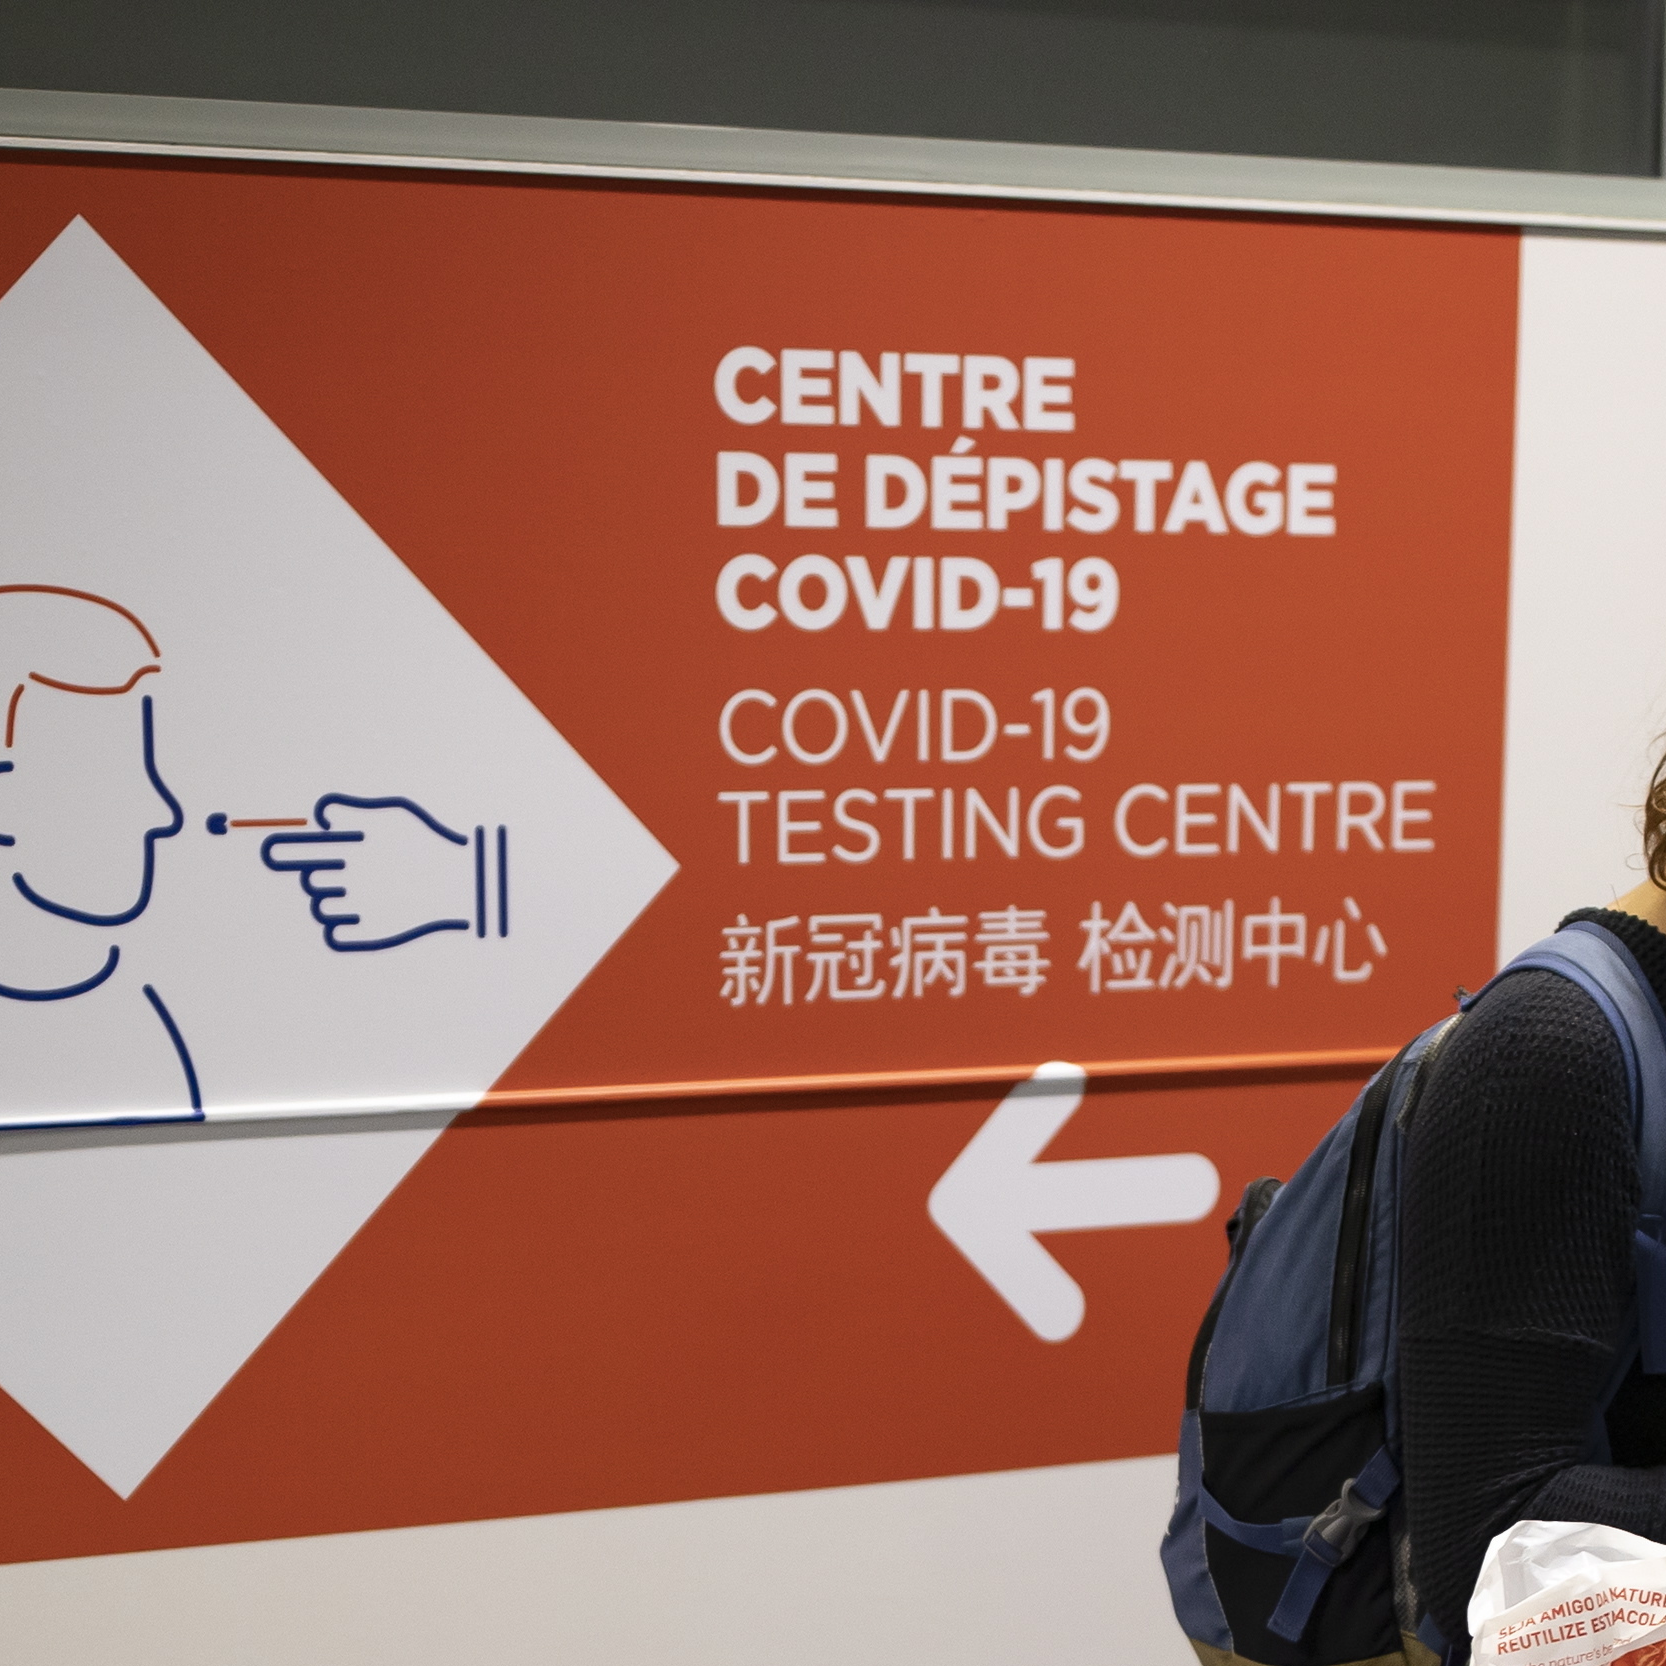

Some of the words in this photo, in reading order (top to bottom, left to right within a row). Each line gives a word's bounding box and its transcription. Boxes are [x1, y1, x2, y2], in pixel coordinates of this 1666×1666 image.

[714, 345, 1077, 432] CENTRE
[716, 450, 839, 528] DE
[865, 436, 1337, 536] DÉPISTAGE
[715, 552, 1121, 632] COVID-19
[718, 686, 1112, 765] COVID-19
[717, 785, 1085, 865] TESTING
[1114, 780, 1436, 857] CENTRE
[718, 904, 1051, 1008] 新冠病毒
[1077, 896, 1389, 996] 检测中心
[1498, 1618, 1536, 1640] SEJA
[1540, 1597, 1595, 1624] AMIGO
[1596, 1591, 1611, 1608] DA
[1498, 1620, 1588, 1656] REUTILIZE
